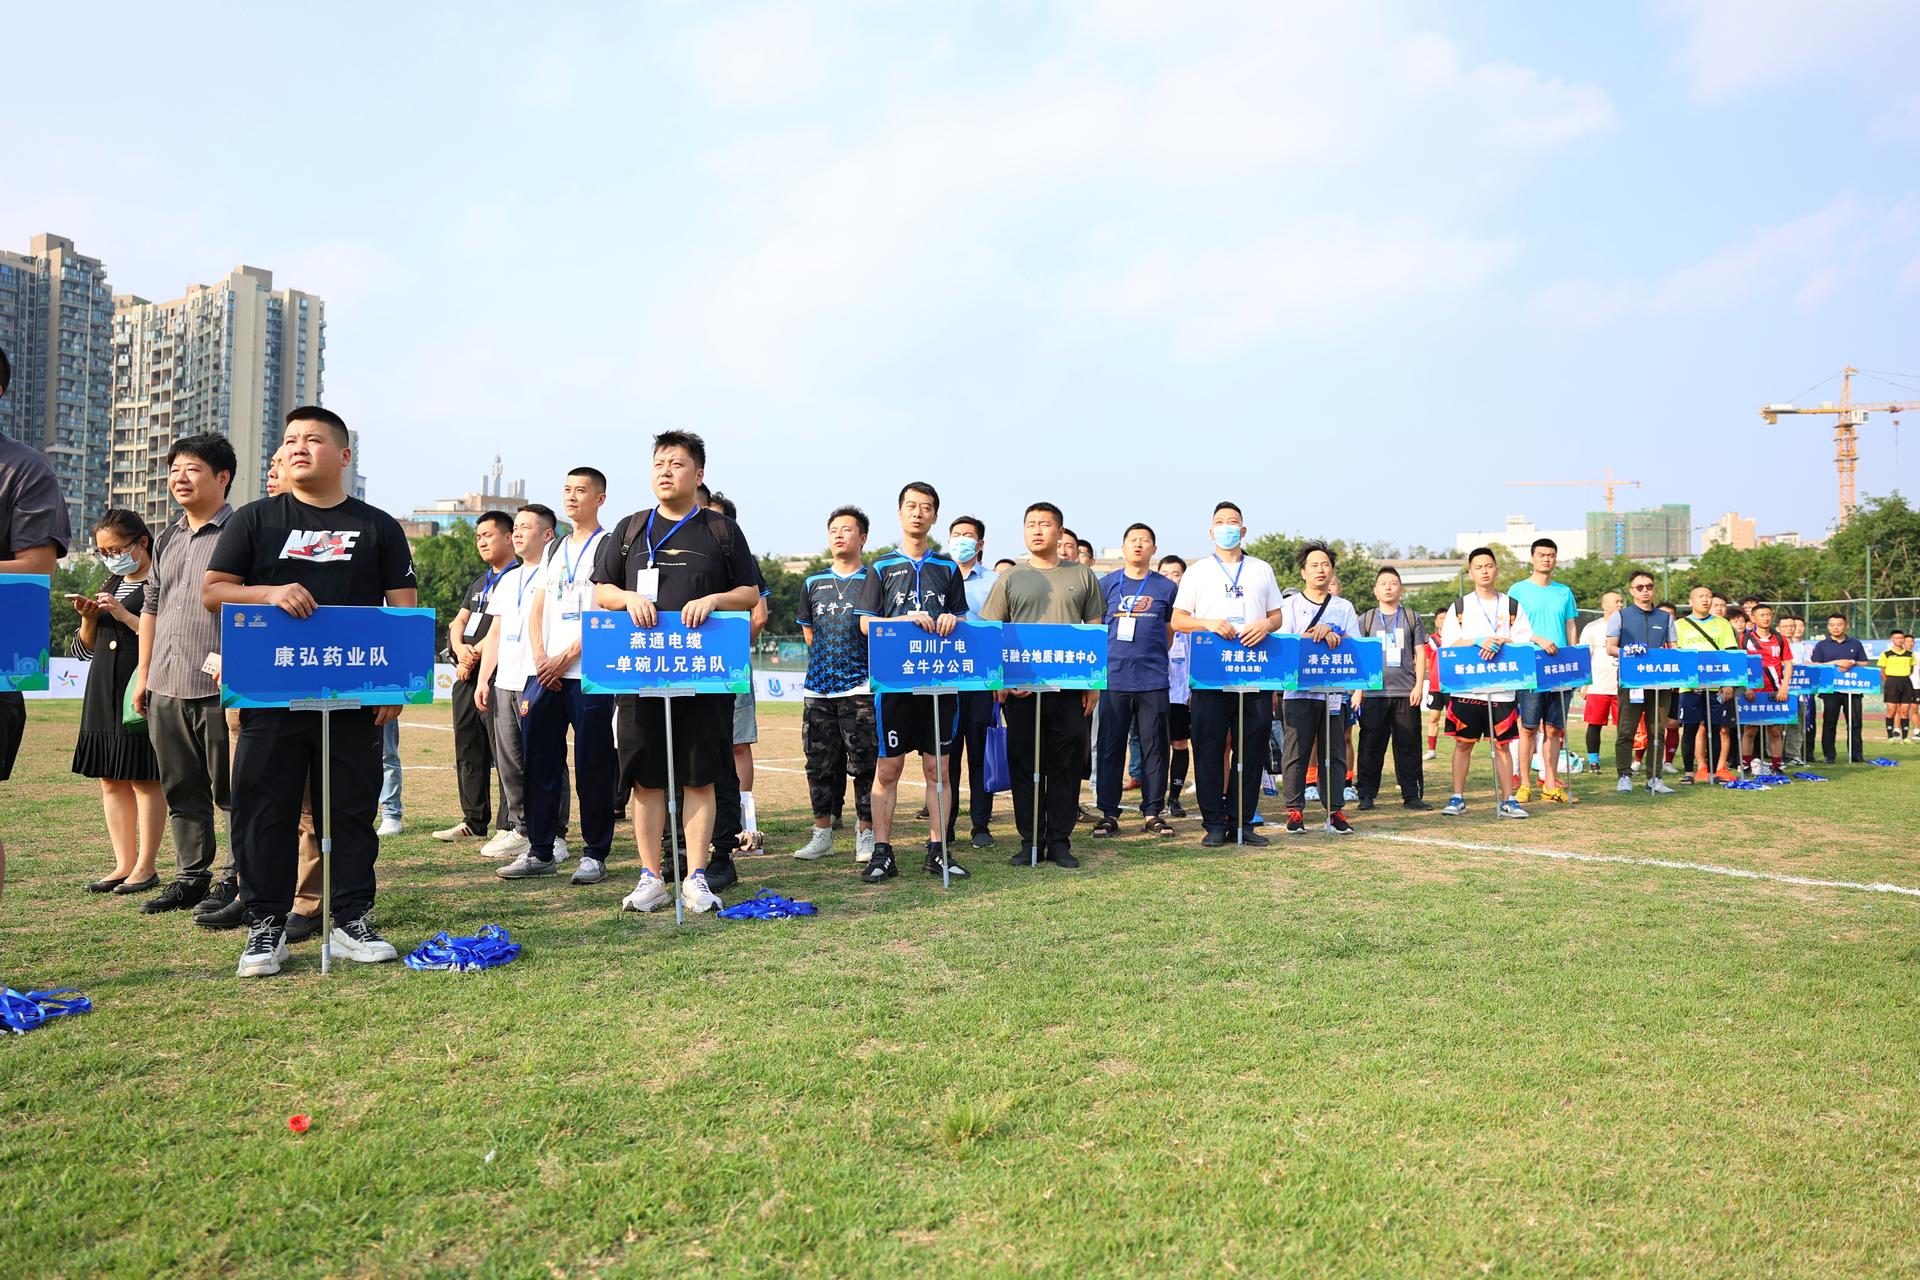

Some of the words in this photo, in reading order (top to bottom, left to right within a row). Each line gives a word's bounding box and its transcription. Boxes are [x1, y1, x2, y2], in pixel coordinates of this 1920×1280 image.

[278, 529, 362, 562] NIE
[630, 632, 703, 650] 燕通电缆
[909, 639, 967, 654] 四川广电
[274, 646, 388, 668] 康弘药业队
[1001, 648, 1098, 664] 民融合地质调查中心
[1221, 649, 1269, 663] 清道夫队
[1308, 653, 1354, 666] 凑合联队
[902, 659, 974, 675] 金牛分公司
[1454, 660, 1519, 675] 新金泉代表队
[1637, 663, 1680, 673] 中铁八局队
[887, 729, 899, 749] 6
